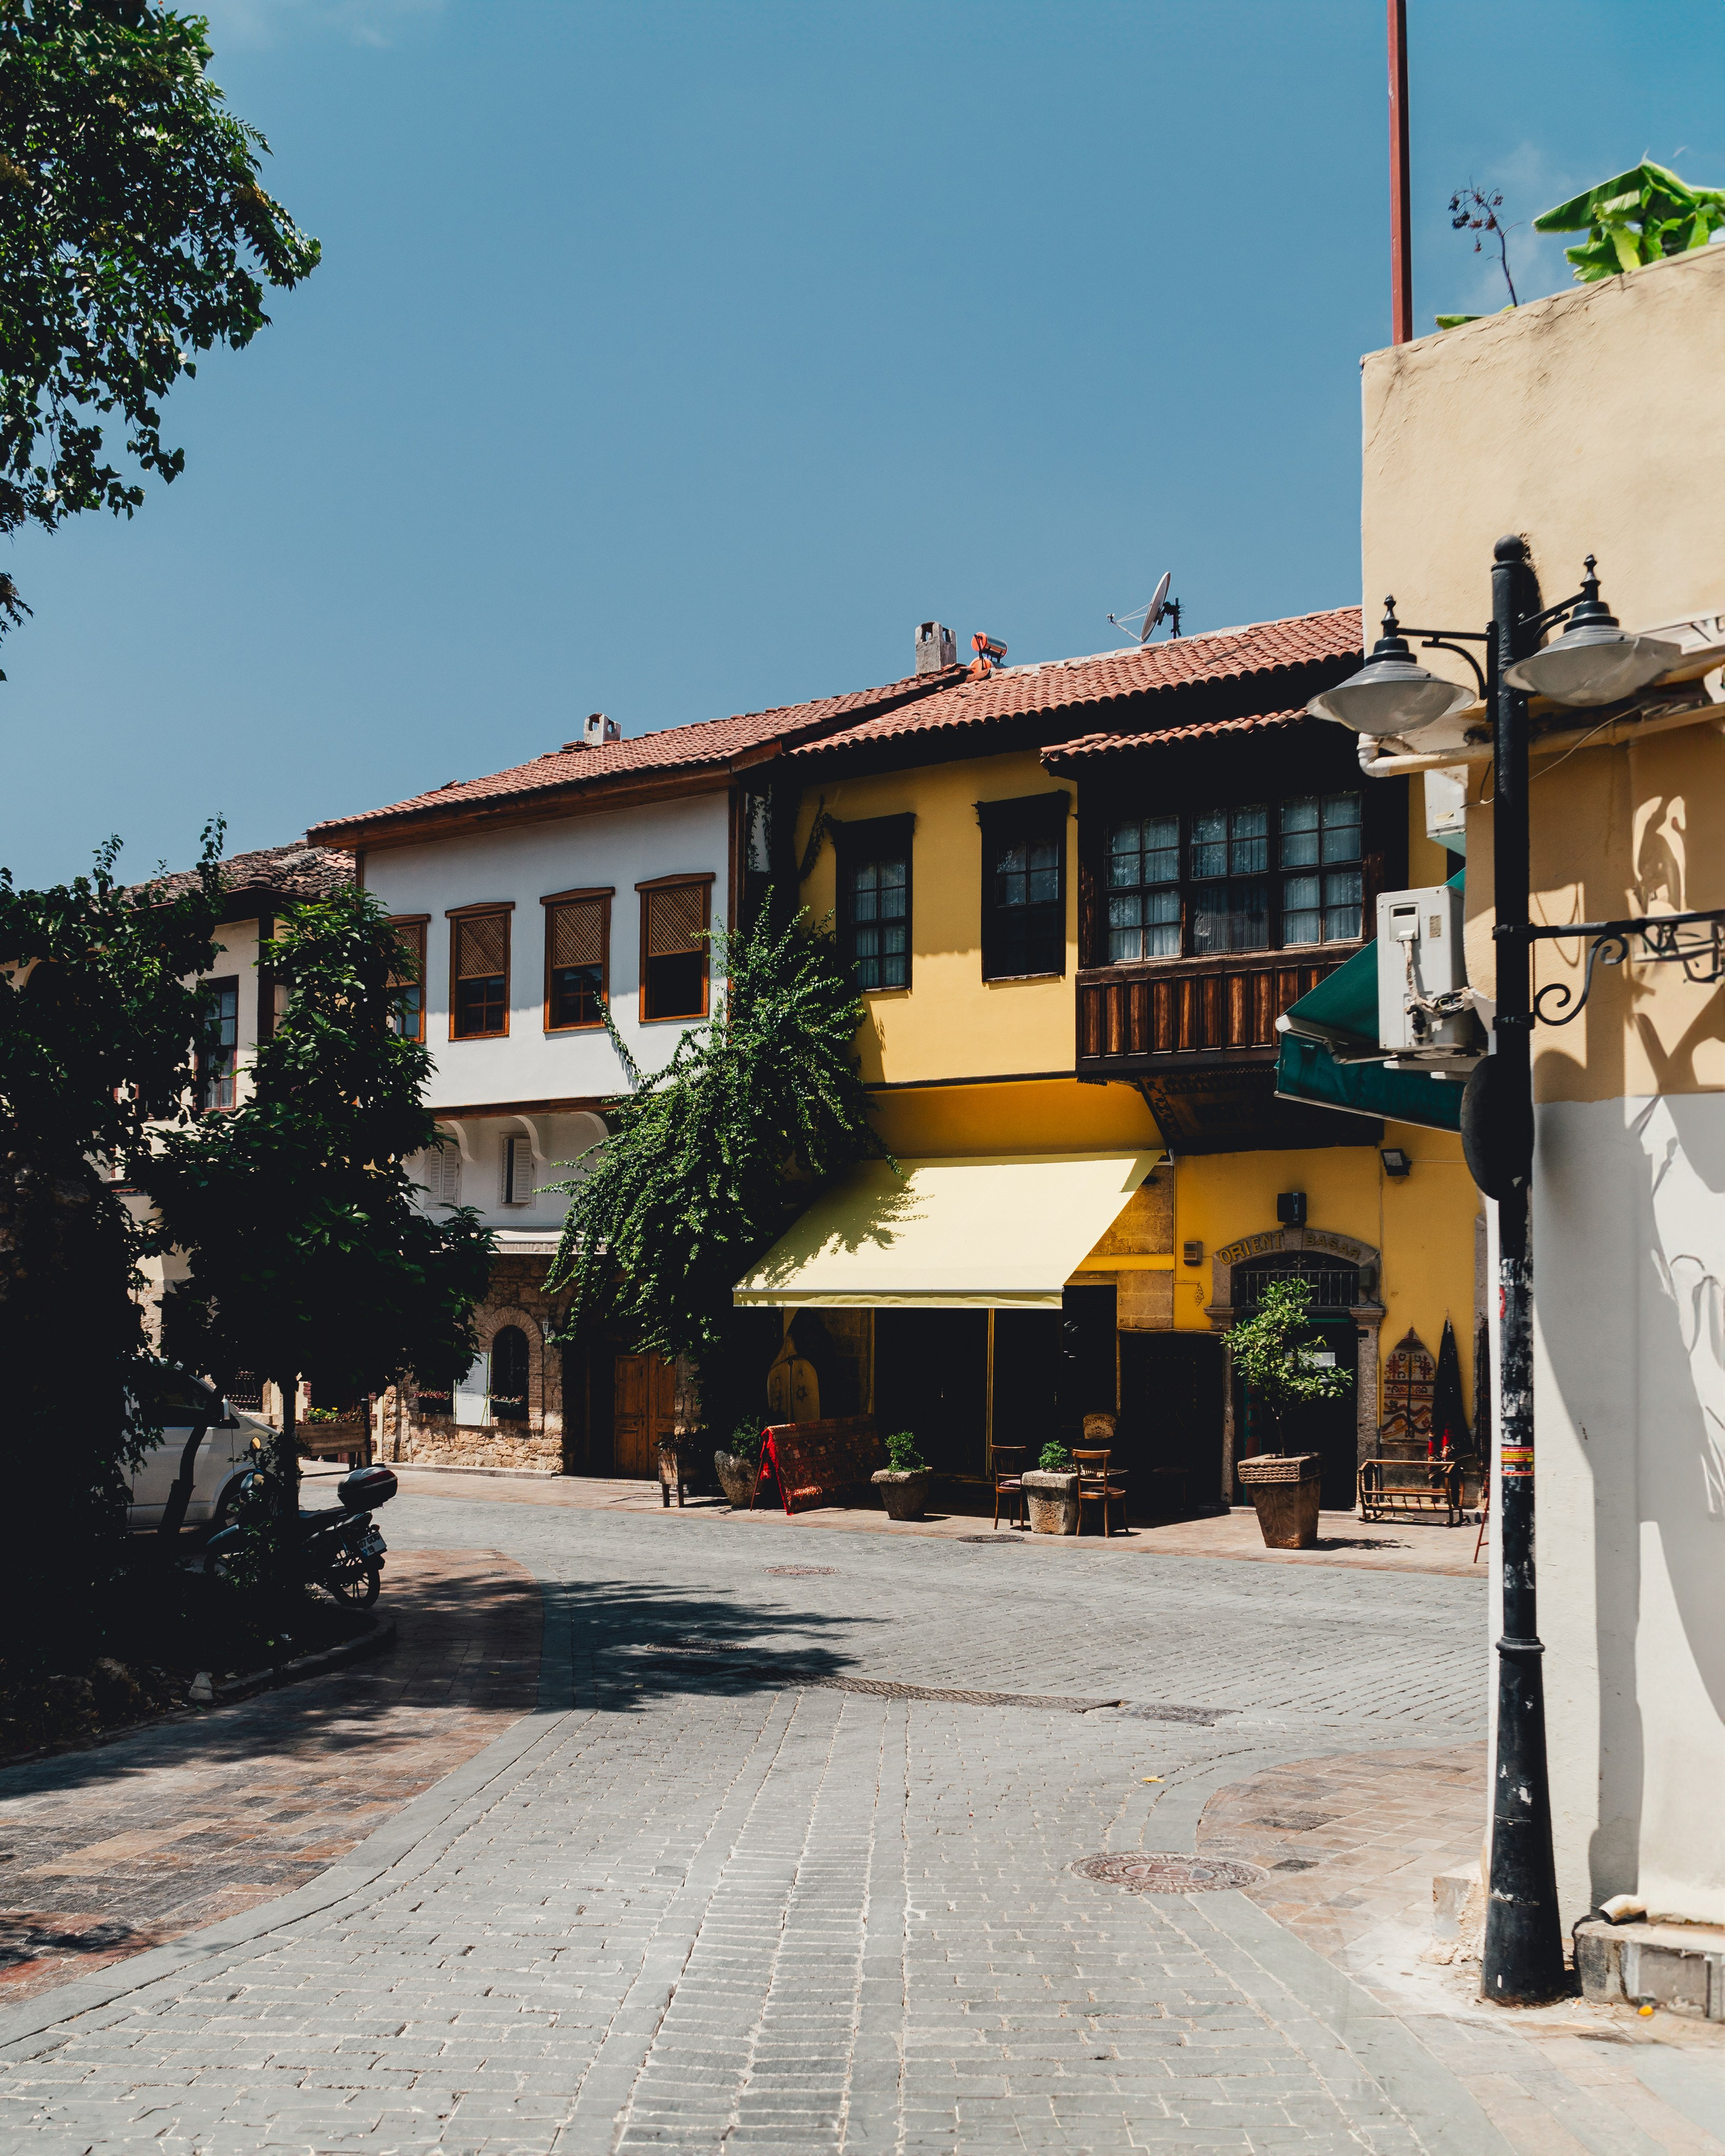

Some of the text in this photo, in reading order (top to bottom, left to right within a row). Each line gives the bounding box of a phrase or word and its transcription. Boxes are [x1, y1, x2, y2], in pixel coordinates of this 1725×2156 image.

[1219, 1232, 1361, 1264] ORIENT BASAR
[358, 1539, 367, 1548] 07
